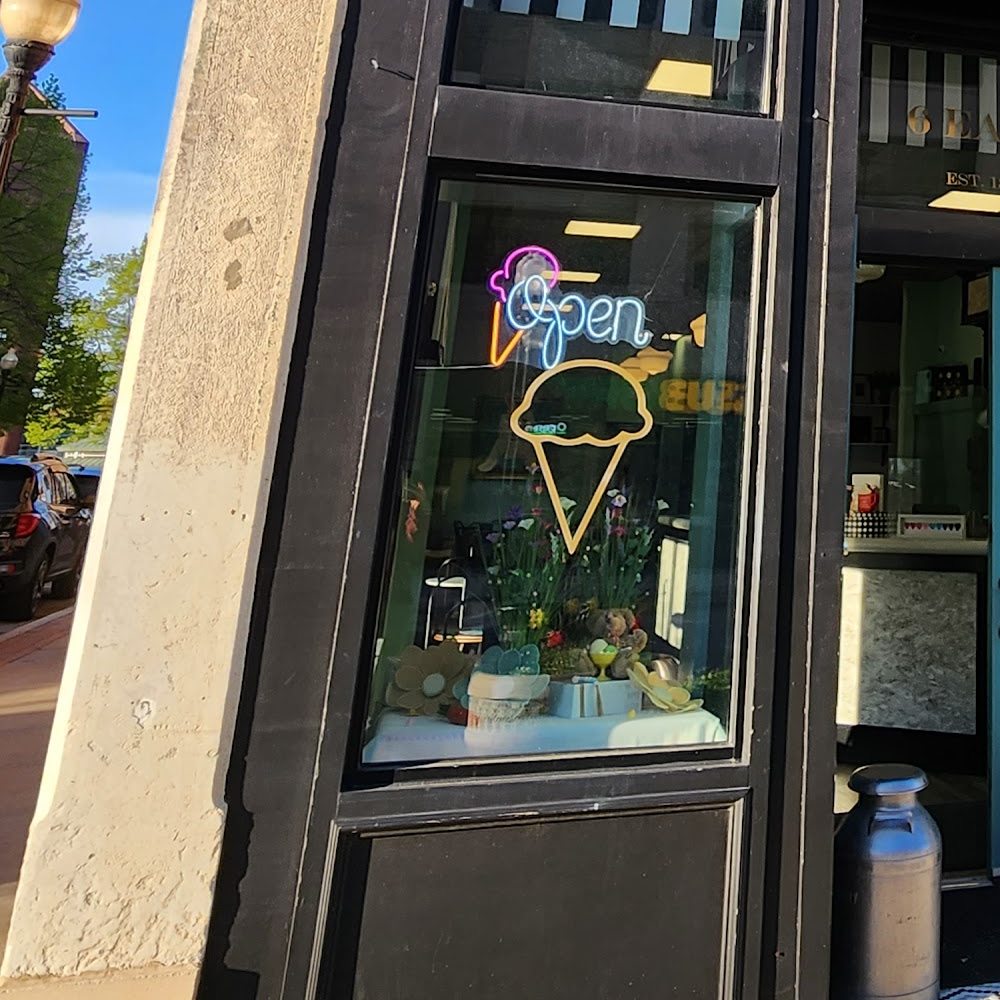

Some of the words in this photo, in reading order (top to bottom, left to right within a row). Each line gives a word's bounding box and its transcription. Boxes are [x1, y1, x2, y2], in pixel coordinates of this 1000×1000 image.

[908, 105, 931, 135] 6
[946, 171, 984, 187] EST.
[507, 274, 651, 369] Open
